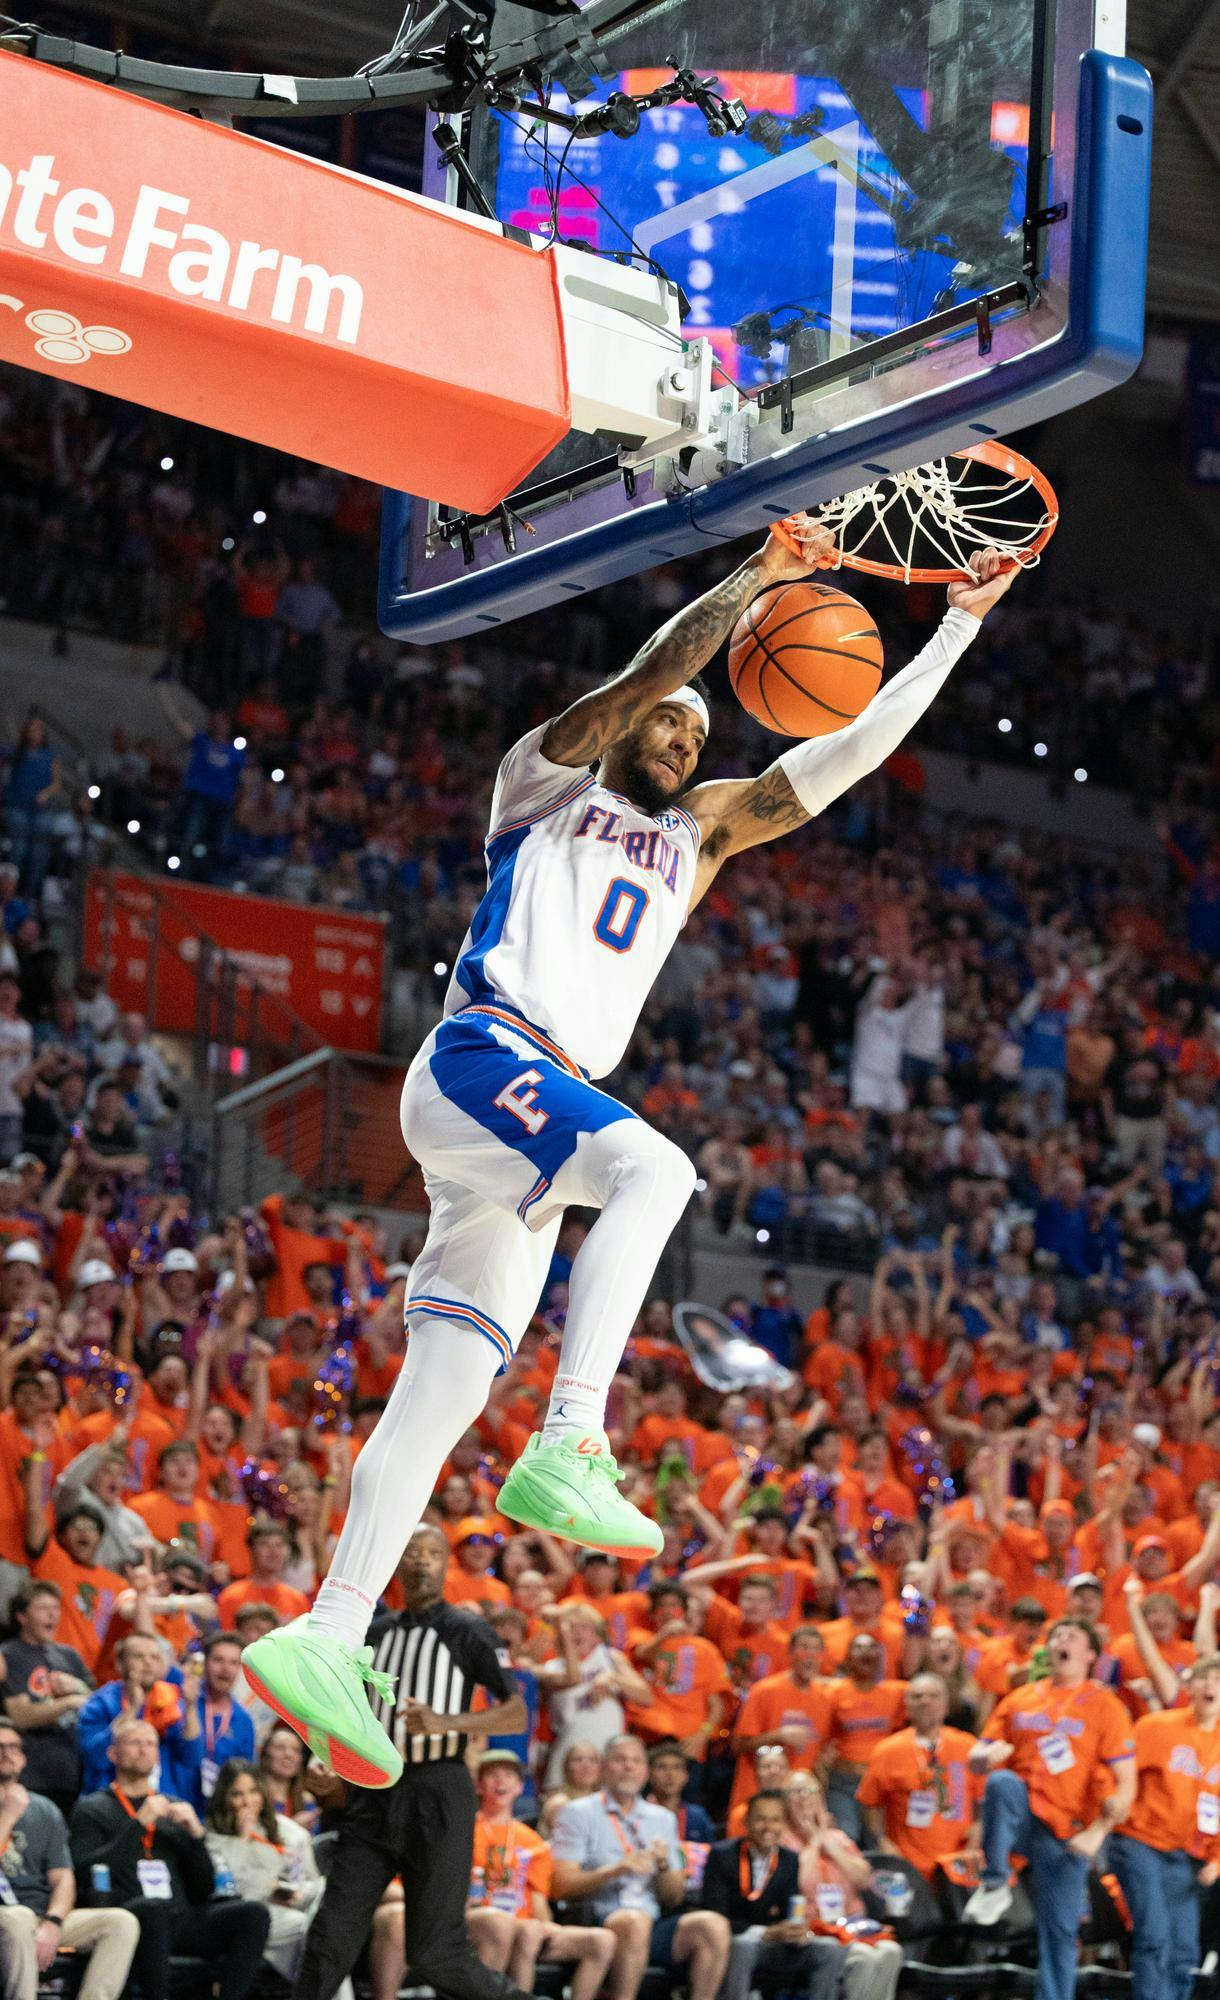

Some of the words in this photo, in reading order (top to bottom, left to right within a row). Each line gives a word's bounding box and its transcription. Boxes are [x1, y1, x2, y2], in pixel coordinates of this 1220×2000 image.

[574, 804, 680, 896] FLRIDA
[592, 876, 650, 955] 0
[492, 1068, 550, 1136] F
